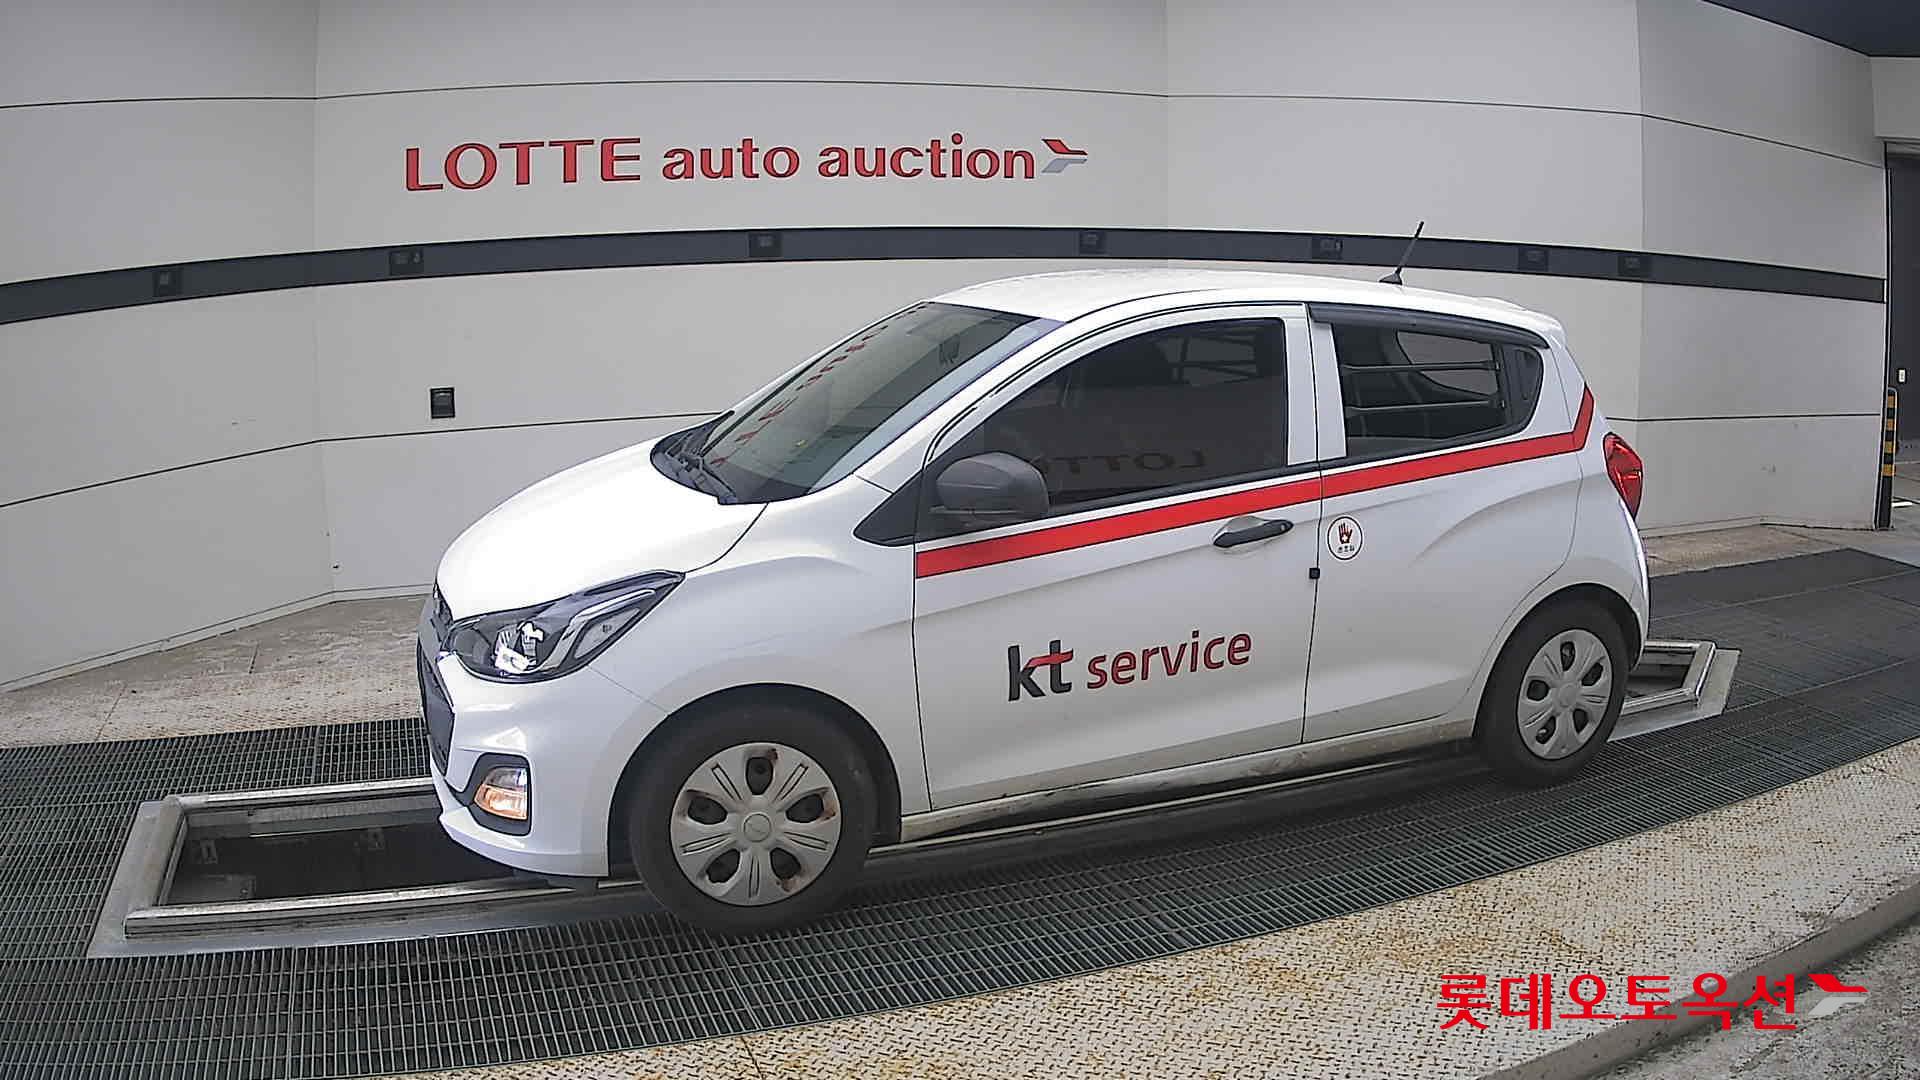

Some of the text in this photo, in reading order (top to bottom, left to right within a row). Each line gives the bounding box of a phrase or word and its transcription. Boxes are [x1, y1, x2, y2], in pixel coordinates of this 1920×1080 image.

[406, 133, 1034, 191] LOTTE auto auction
[1008, 630, 1251, 701] kt service
